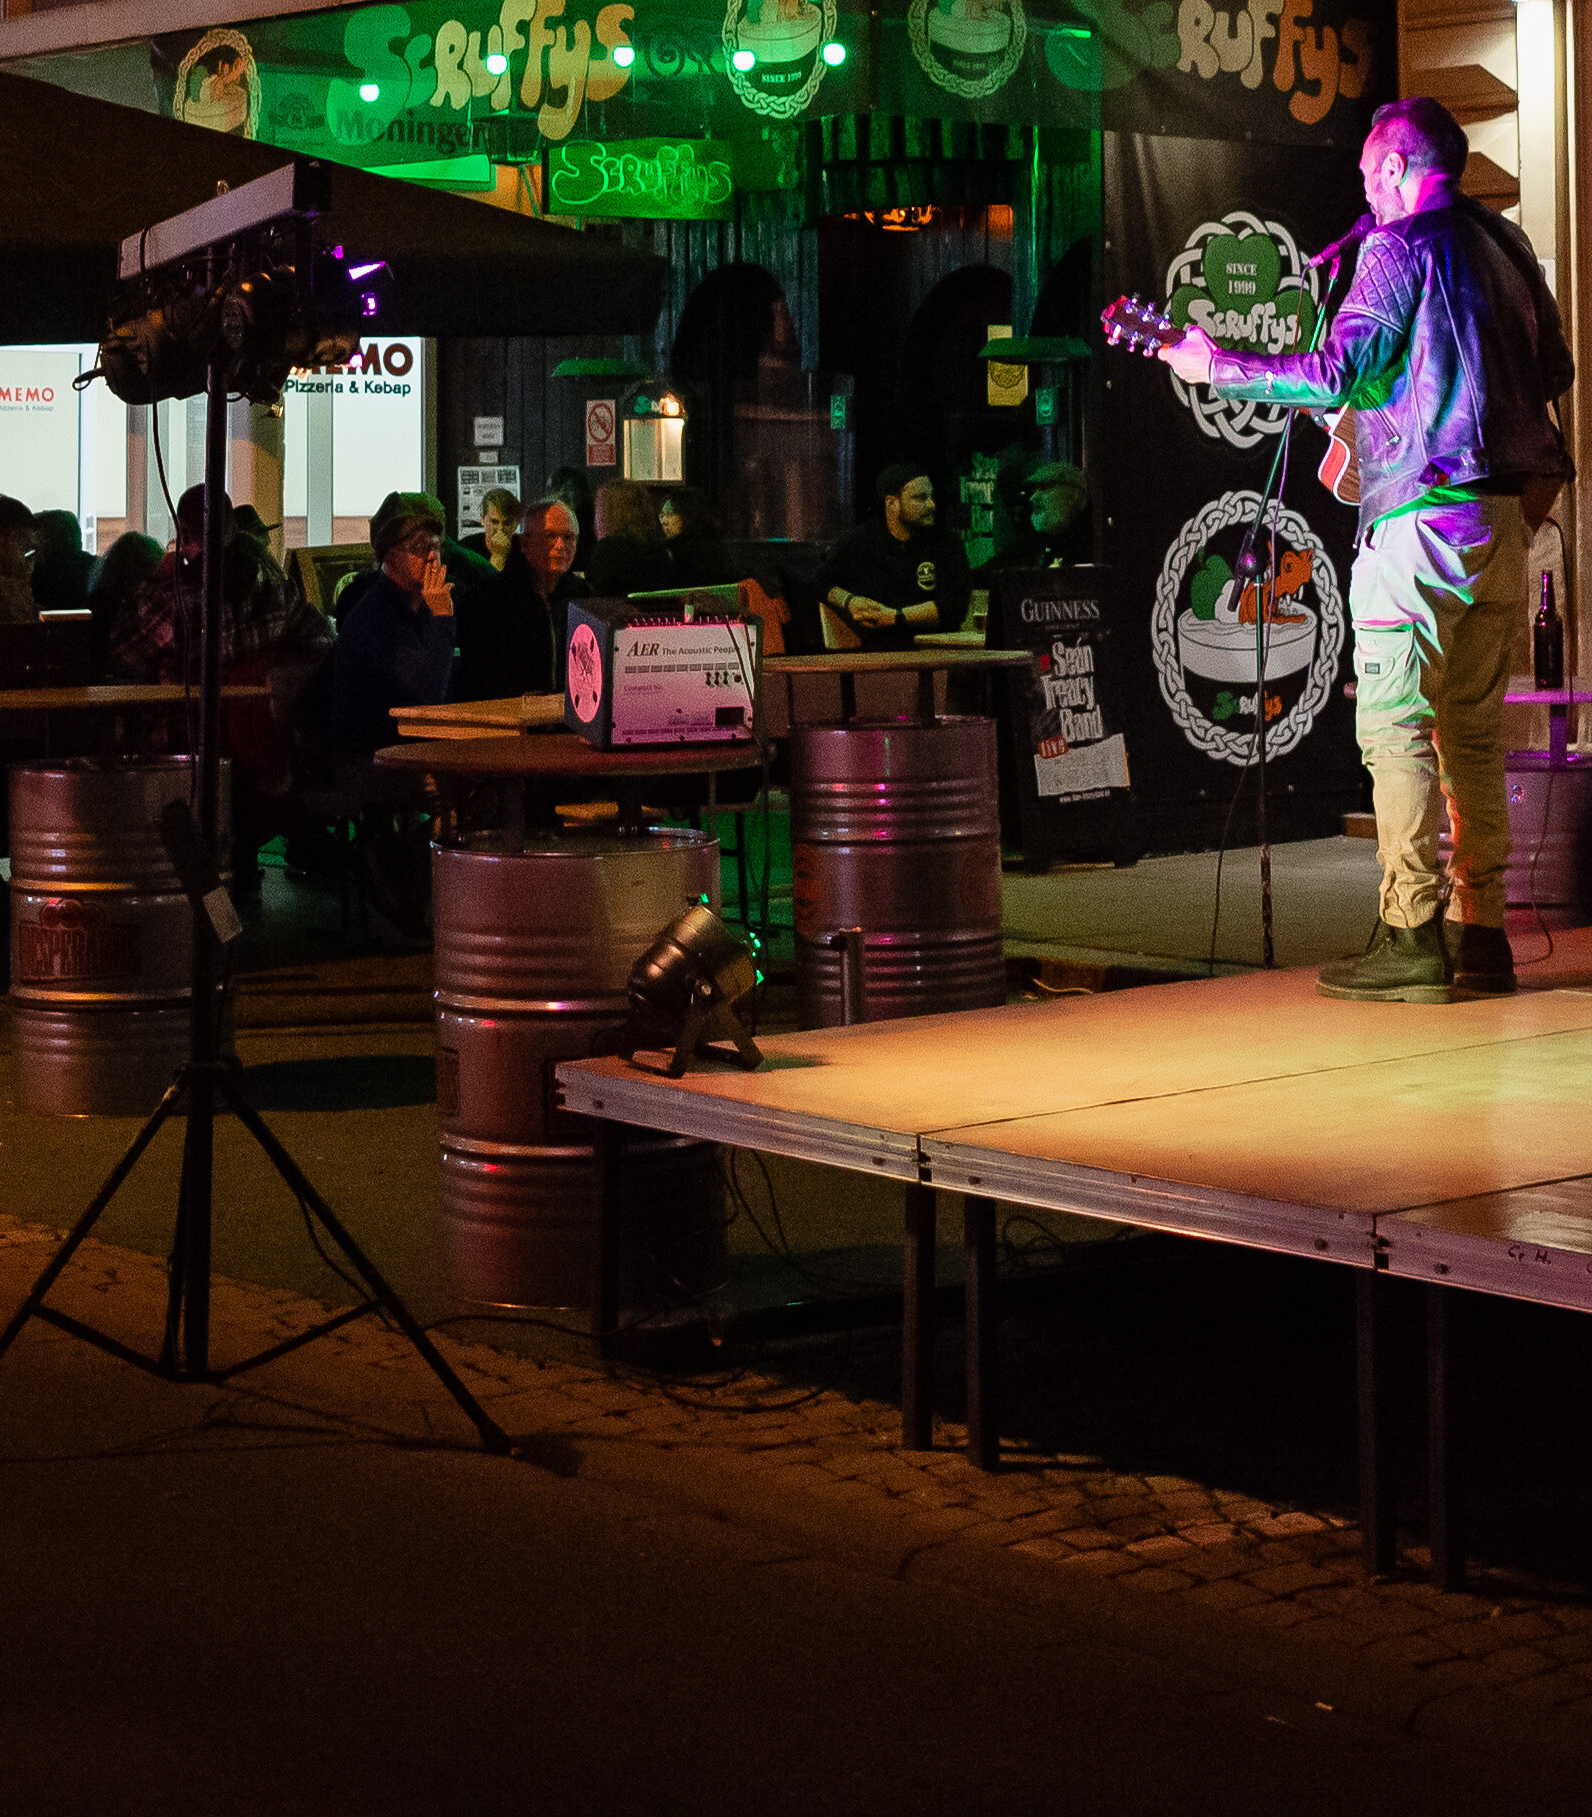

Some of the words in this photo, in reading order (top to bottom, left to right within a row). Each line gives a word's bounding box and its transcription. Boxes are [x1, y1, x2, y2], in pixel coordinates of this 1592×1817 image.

[1225, 263, 1257, 276] SINCE
[285, 380, 344, 393] Pizzeria
[349, 381, 359, 393] &
[364, 380, 411, 397] Kebap
[662, 647, 677, 655] The
[679, 645, 711, 655] Acoustic
[1060, 704, 1103, 743] Band
